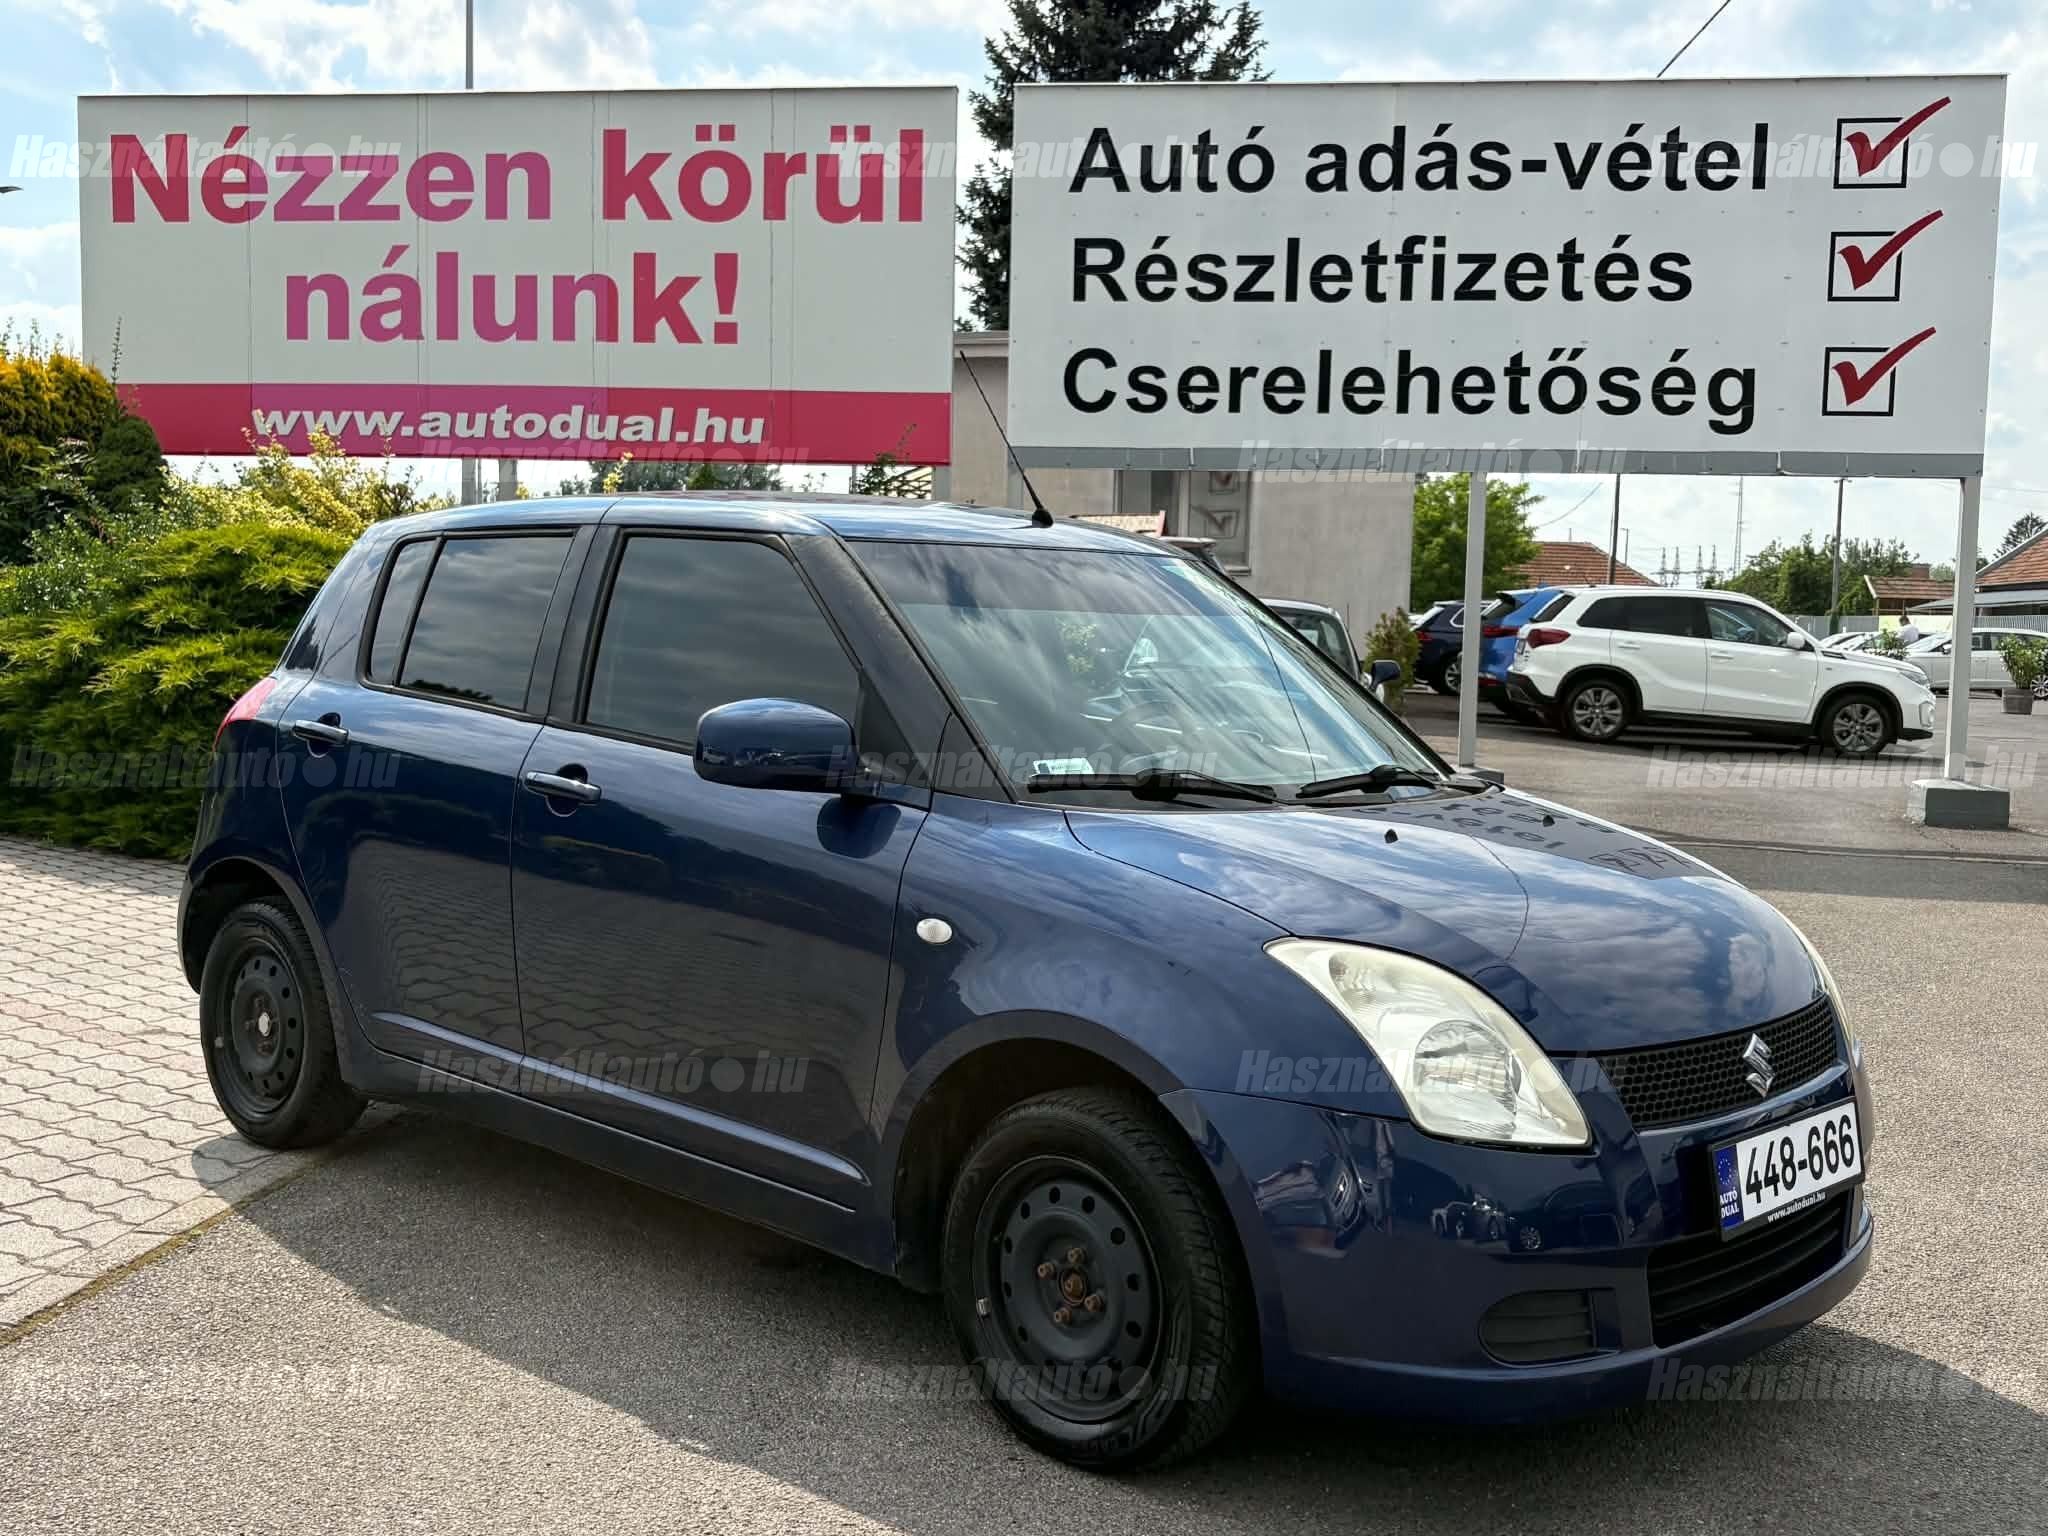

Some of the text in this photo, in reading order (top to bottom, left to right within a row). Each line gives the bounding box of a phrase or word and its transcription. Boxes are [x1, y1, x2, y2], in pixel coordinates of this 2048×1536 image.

[110, 124, 925, 225] Nézzen körül
[1068, 122, 1769, 193] Autó adás-vétel
[286, 244, 739, 345] nálunk!
[1071, 235, 1693, 303] Részletfizetés
[251, 404, 765, 445] www.autodual.hu
[1062, 347, 1756, 435] Cserelehetőség
[1746, 1115, 1854, 1204] 448-666
[1721, 1203, 1740, 1218] DUAL
[1767, 1190, 1826, 1223] www.autodual.hu
